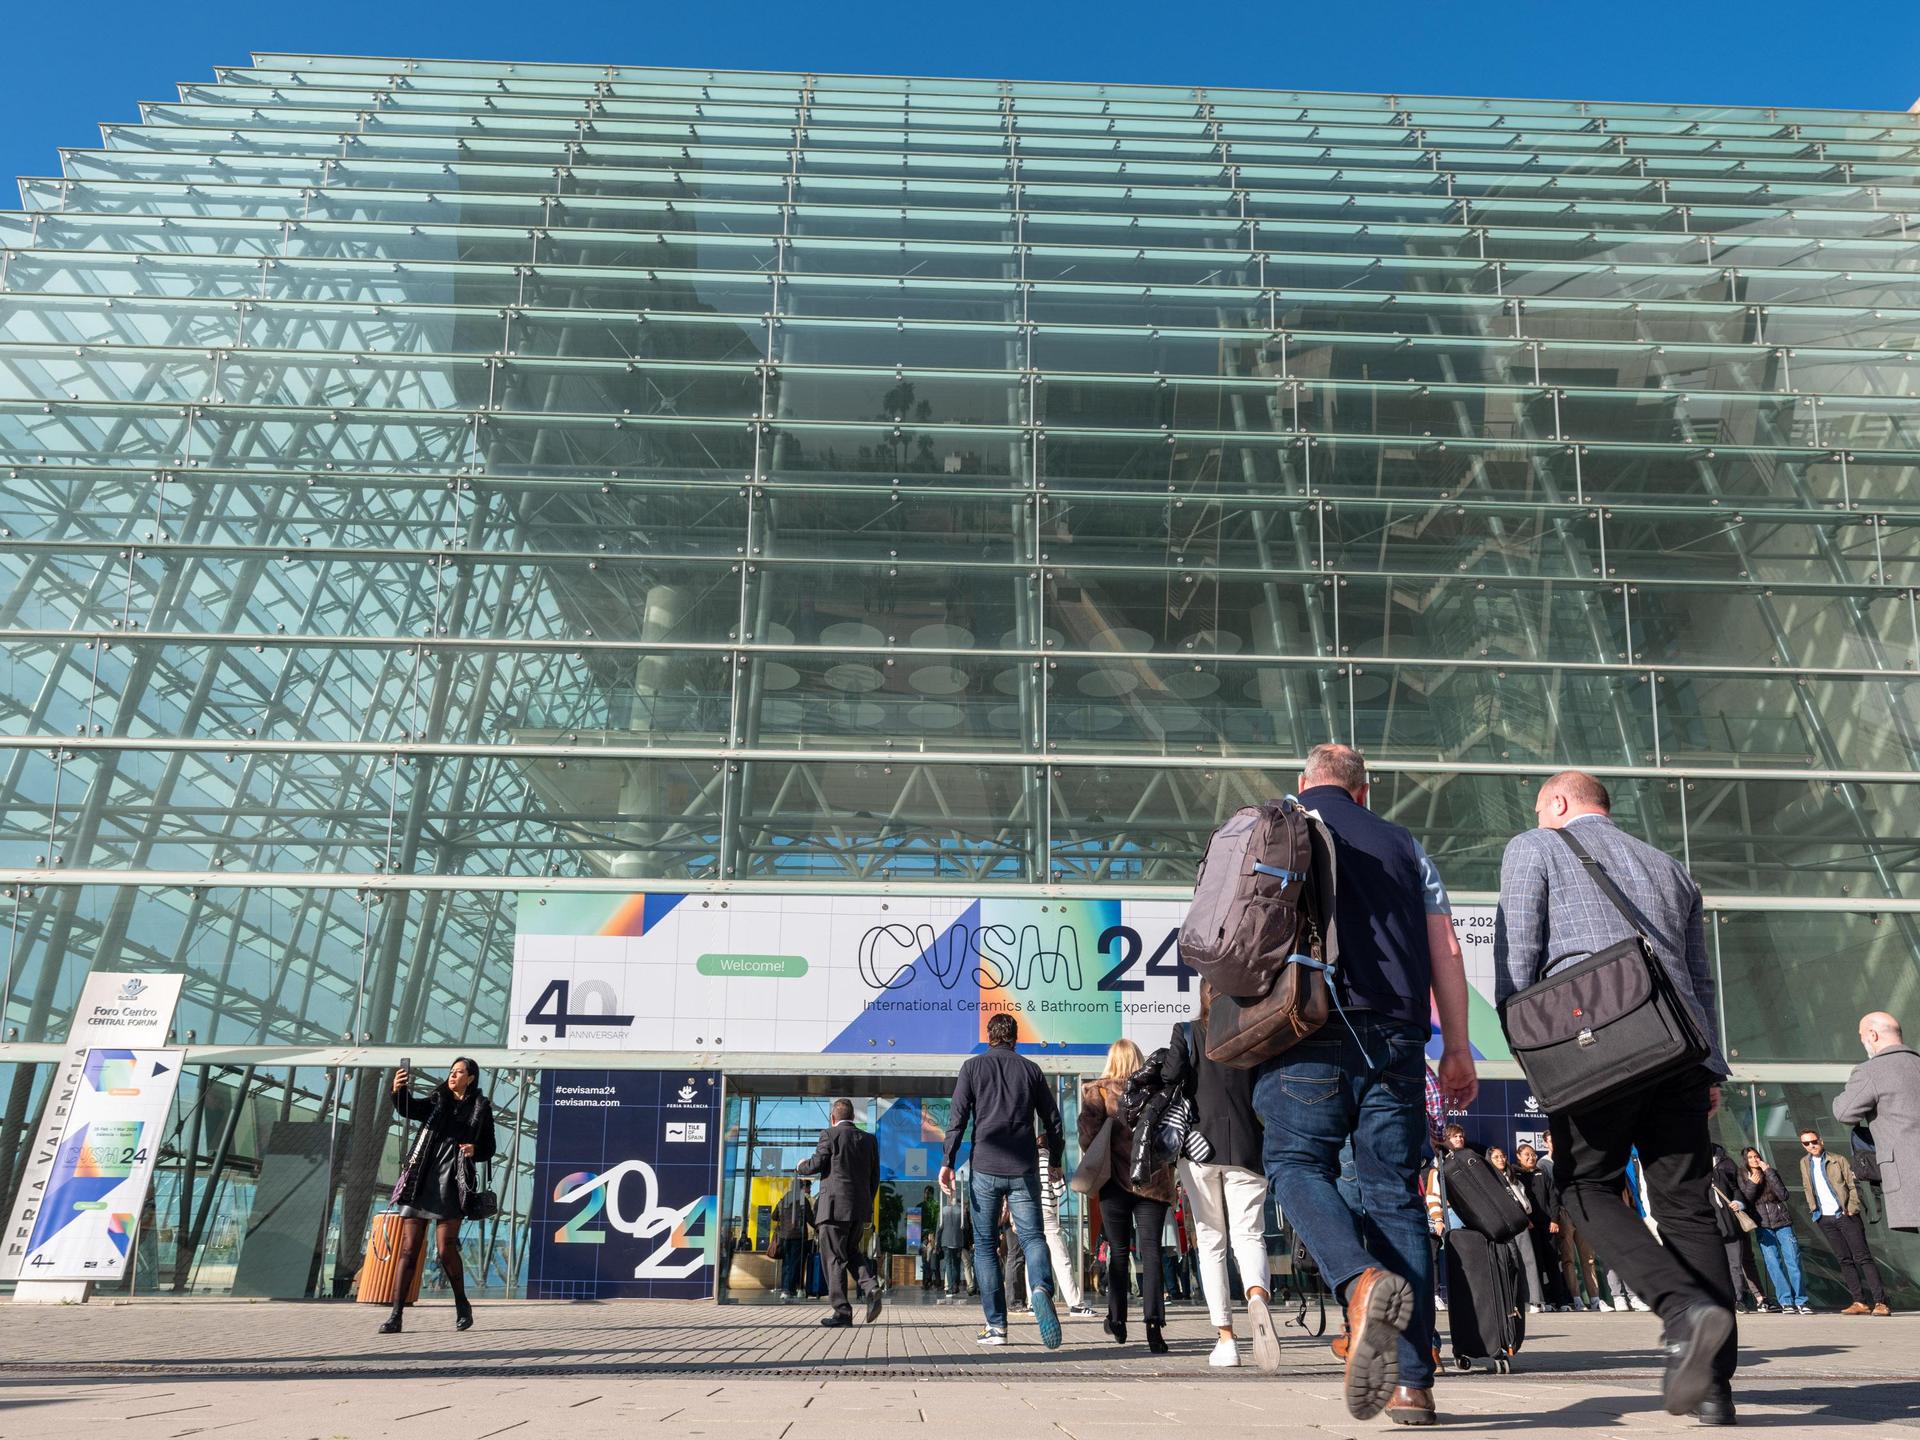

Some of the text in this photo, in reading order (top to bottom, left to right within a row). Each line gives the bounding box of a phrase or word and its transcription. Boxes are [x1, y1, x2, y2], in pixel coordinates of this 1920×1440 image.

[1452, 918, 1465, 927] ar
[1466, 933, 1494, 946] Spai
[1096, 925, 1199, 993] 24
[720, 960, 785, 973] Welcome!
[94, 1006, 157, 1017] Foro Centro
[863, 999, 1191, 1016] International Ceramics & Bathroom Experience
[87, 1017, 158, 1027] CENTRAL FORUM
[570, 1031, 630, 1040] ANNIVERSARY
[555, 1086, 616, 1095] #cevisama24
[554, 1098, 620, 1107] cevisama.com
[120, 1148, 147, 1164] 24
